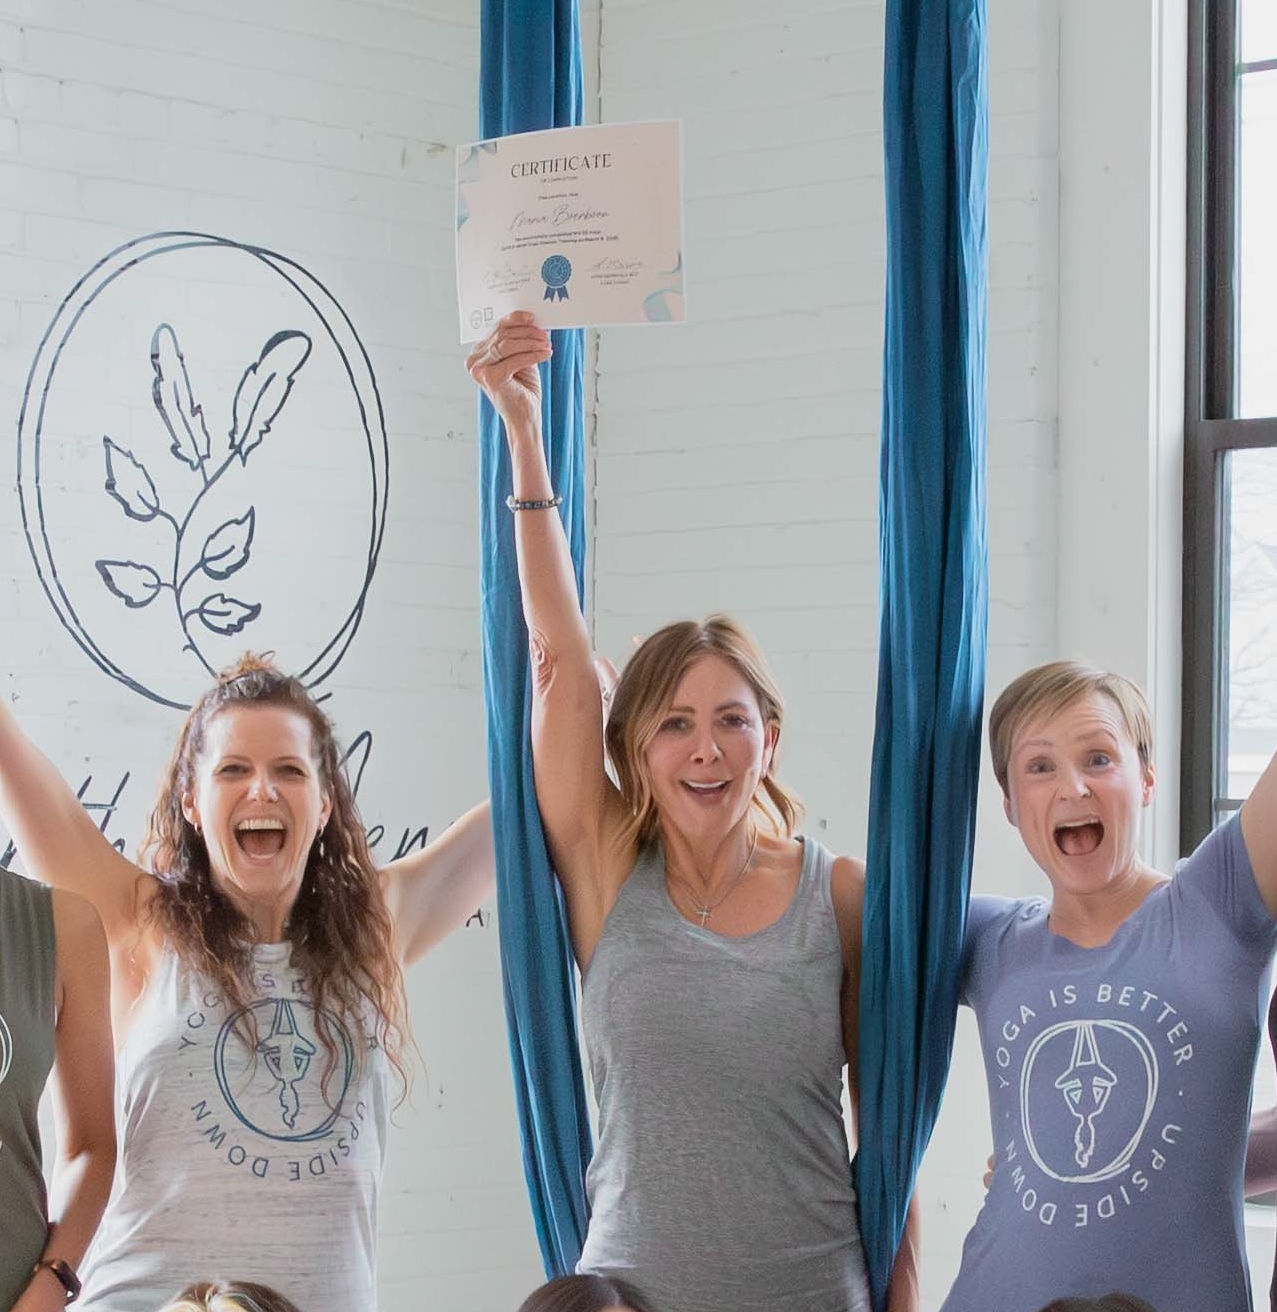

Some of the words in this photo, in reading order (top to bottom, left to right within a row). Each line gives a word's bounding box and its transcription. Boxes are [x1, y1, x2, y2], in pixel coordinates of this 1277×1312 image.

[511, 153, 612, 178] CERTIFICATE
[996, 1005, 1036, 1089] YOGA
[1049, 985, 1077, 1008] IS
[1096, 984, 1193, 1066] BETTER
[191, 1099, 269, 1178] DOWN
[289, 1101, 368, 1181] UPSIDE
[1075, 1124, 1183, 1228] UPSIDE
[1006, 1140, 1057, 1225] DOWN
